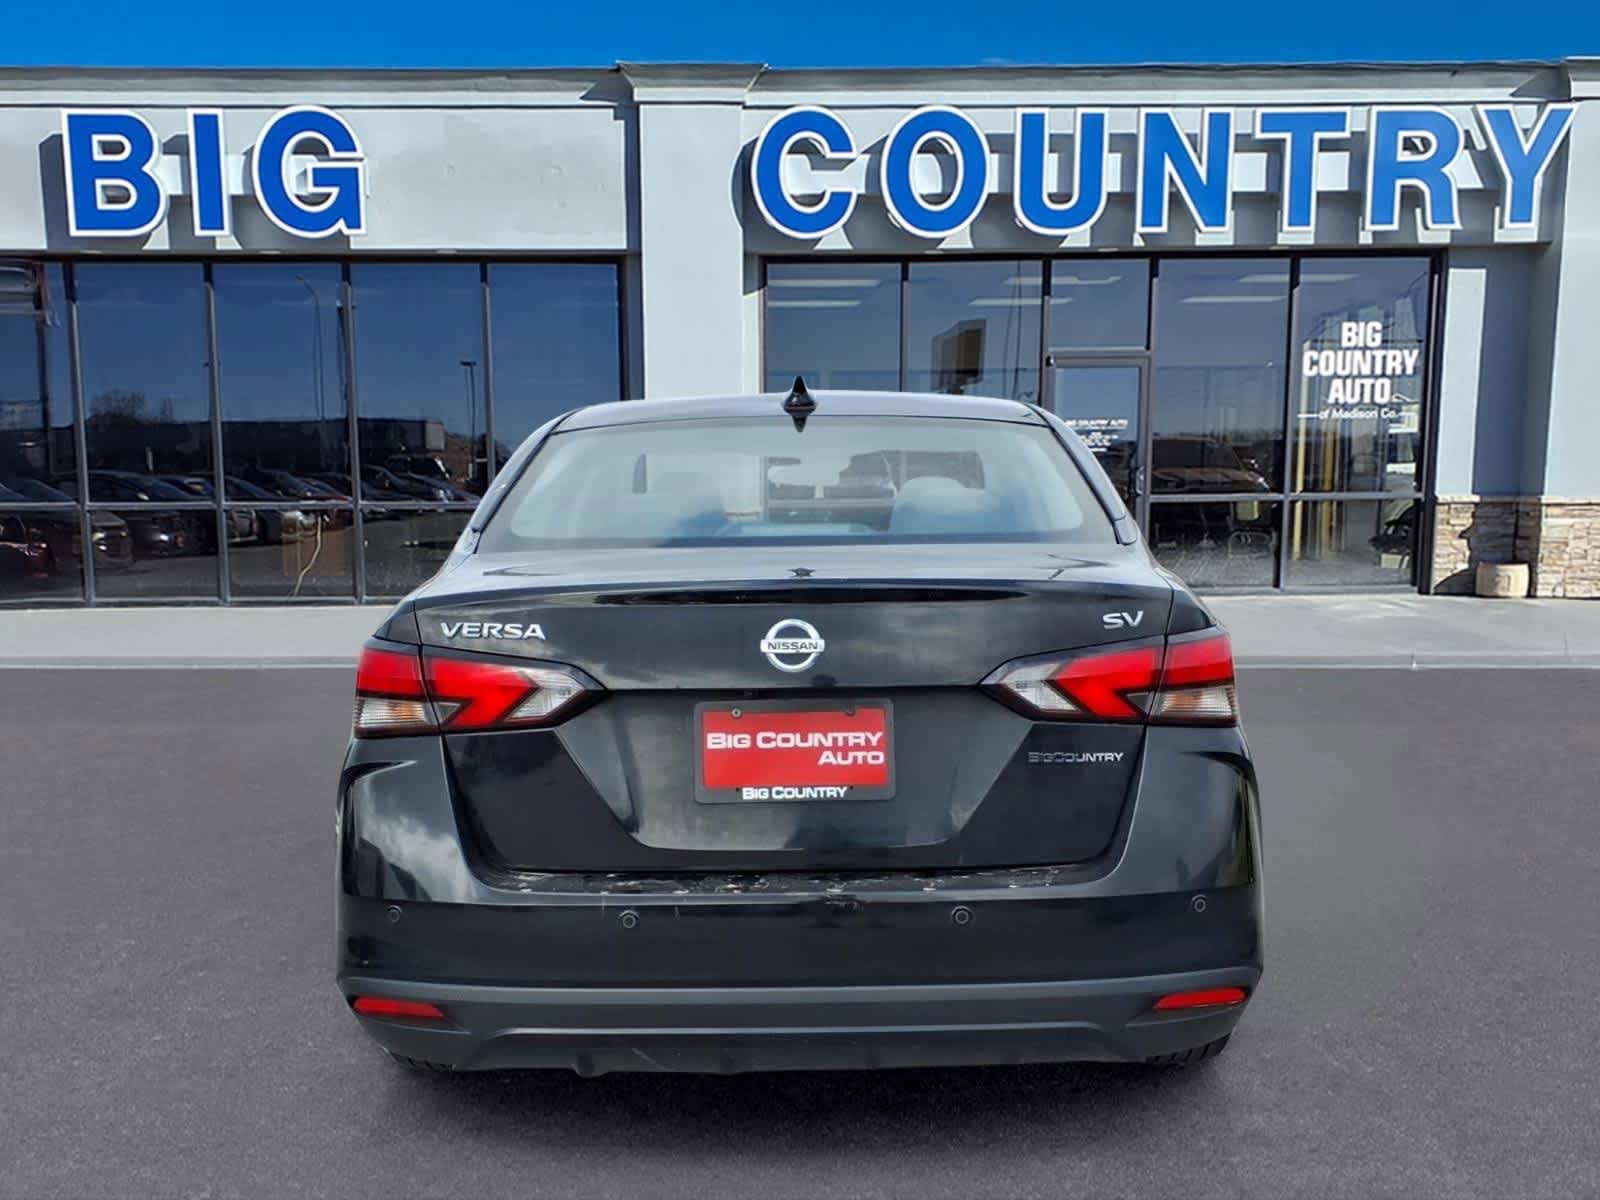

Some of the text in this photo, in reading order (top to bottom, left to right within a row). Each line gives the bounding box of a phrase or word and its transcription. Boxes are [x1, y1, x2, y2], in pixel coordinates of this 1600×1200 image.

[61, 104, 1574, 240] BIG COUNTRY
[1341, 321, 1382, 348] BIG
[1302, 349, 1419, 376] COUNTRY
[1327, 378, 1391, 404] AUTO
[440, 622, 546, 640] VERSA
[1102, 610, 1144, 630] SV
[767, 641, 818, 650] NISSAN
